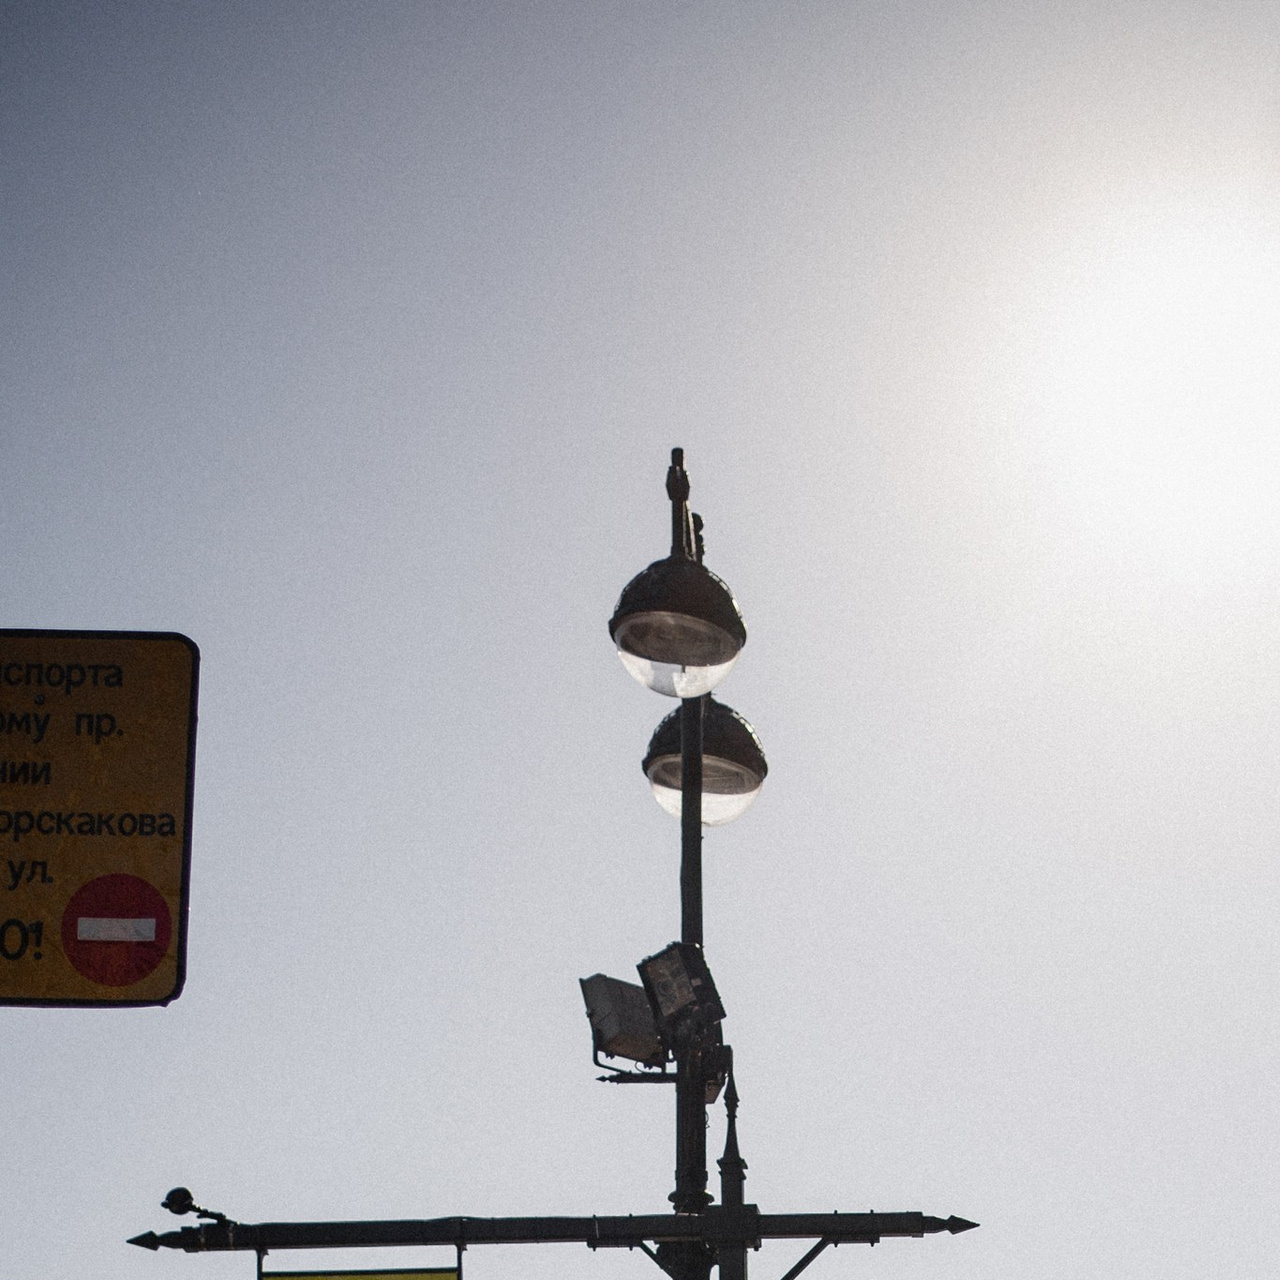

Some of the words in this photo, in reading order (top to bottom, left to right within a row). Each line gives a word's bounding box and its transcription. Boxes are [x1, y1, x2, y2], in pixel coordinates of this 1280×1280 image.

[0, 662, 124, 695] спорта
[75, 712, 124, 745] пр.
[7, 859, 54, 890] ул.
